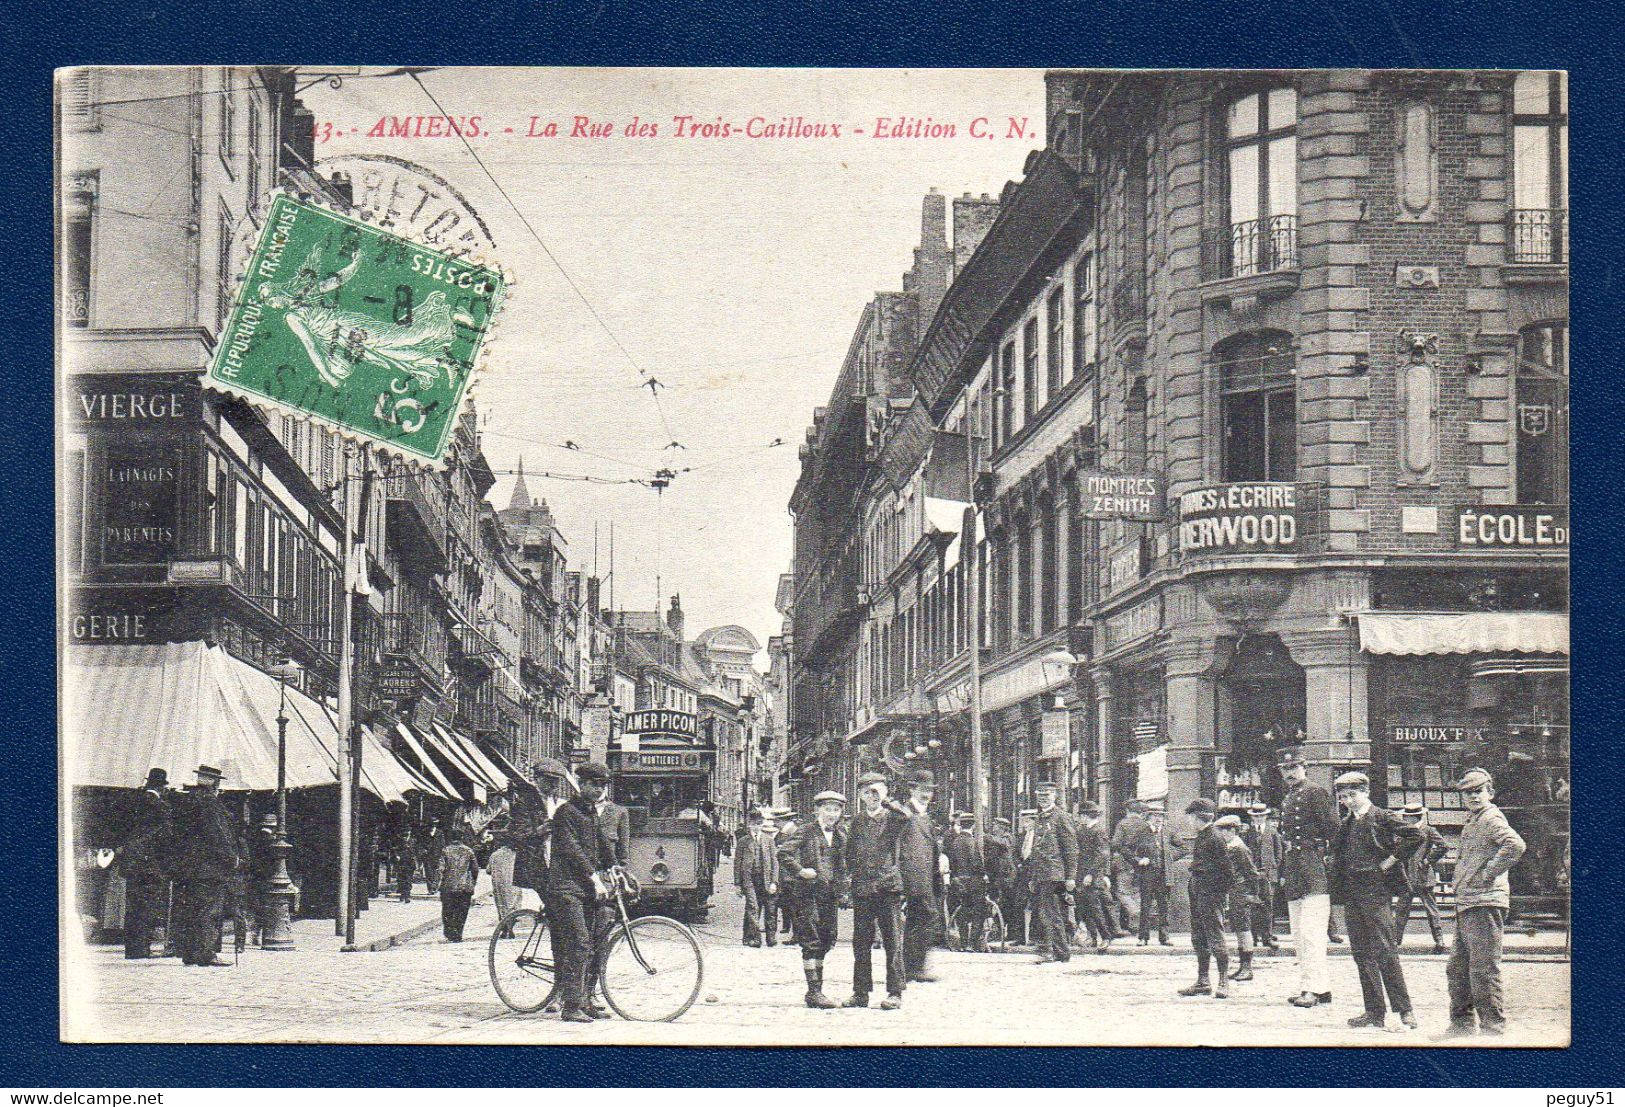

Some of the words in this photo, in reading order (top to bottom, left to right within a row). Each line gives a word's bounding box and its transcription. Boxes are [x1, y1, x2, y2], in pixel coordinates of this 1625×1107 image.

[411, 253, 488, 296] POSTES
[80, 394, 186, 418] VIERGE
[108, 466, 174, 483] LAINAGES
[1087, 476, 1155, 496] MONTRES
[1093, 497, 1150, 513] ZENITH
[1460, 509, 1553, 544] ÉCOLE
[73, 615, 146, 640] GERIE
[627, 712, 659, 732] AMER
[660, 712, 696, 733] PICON
[1395, 727, 1448, 741] BIJOUX
